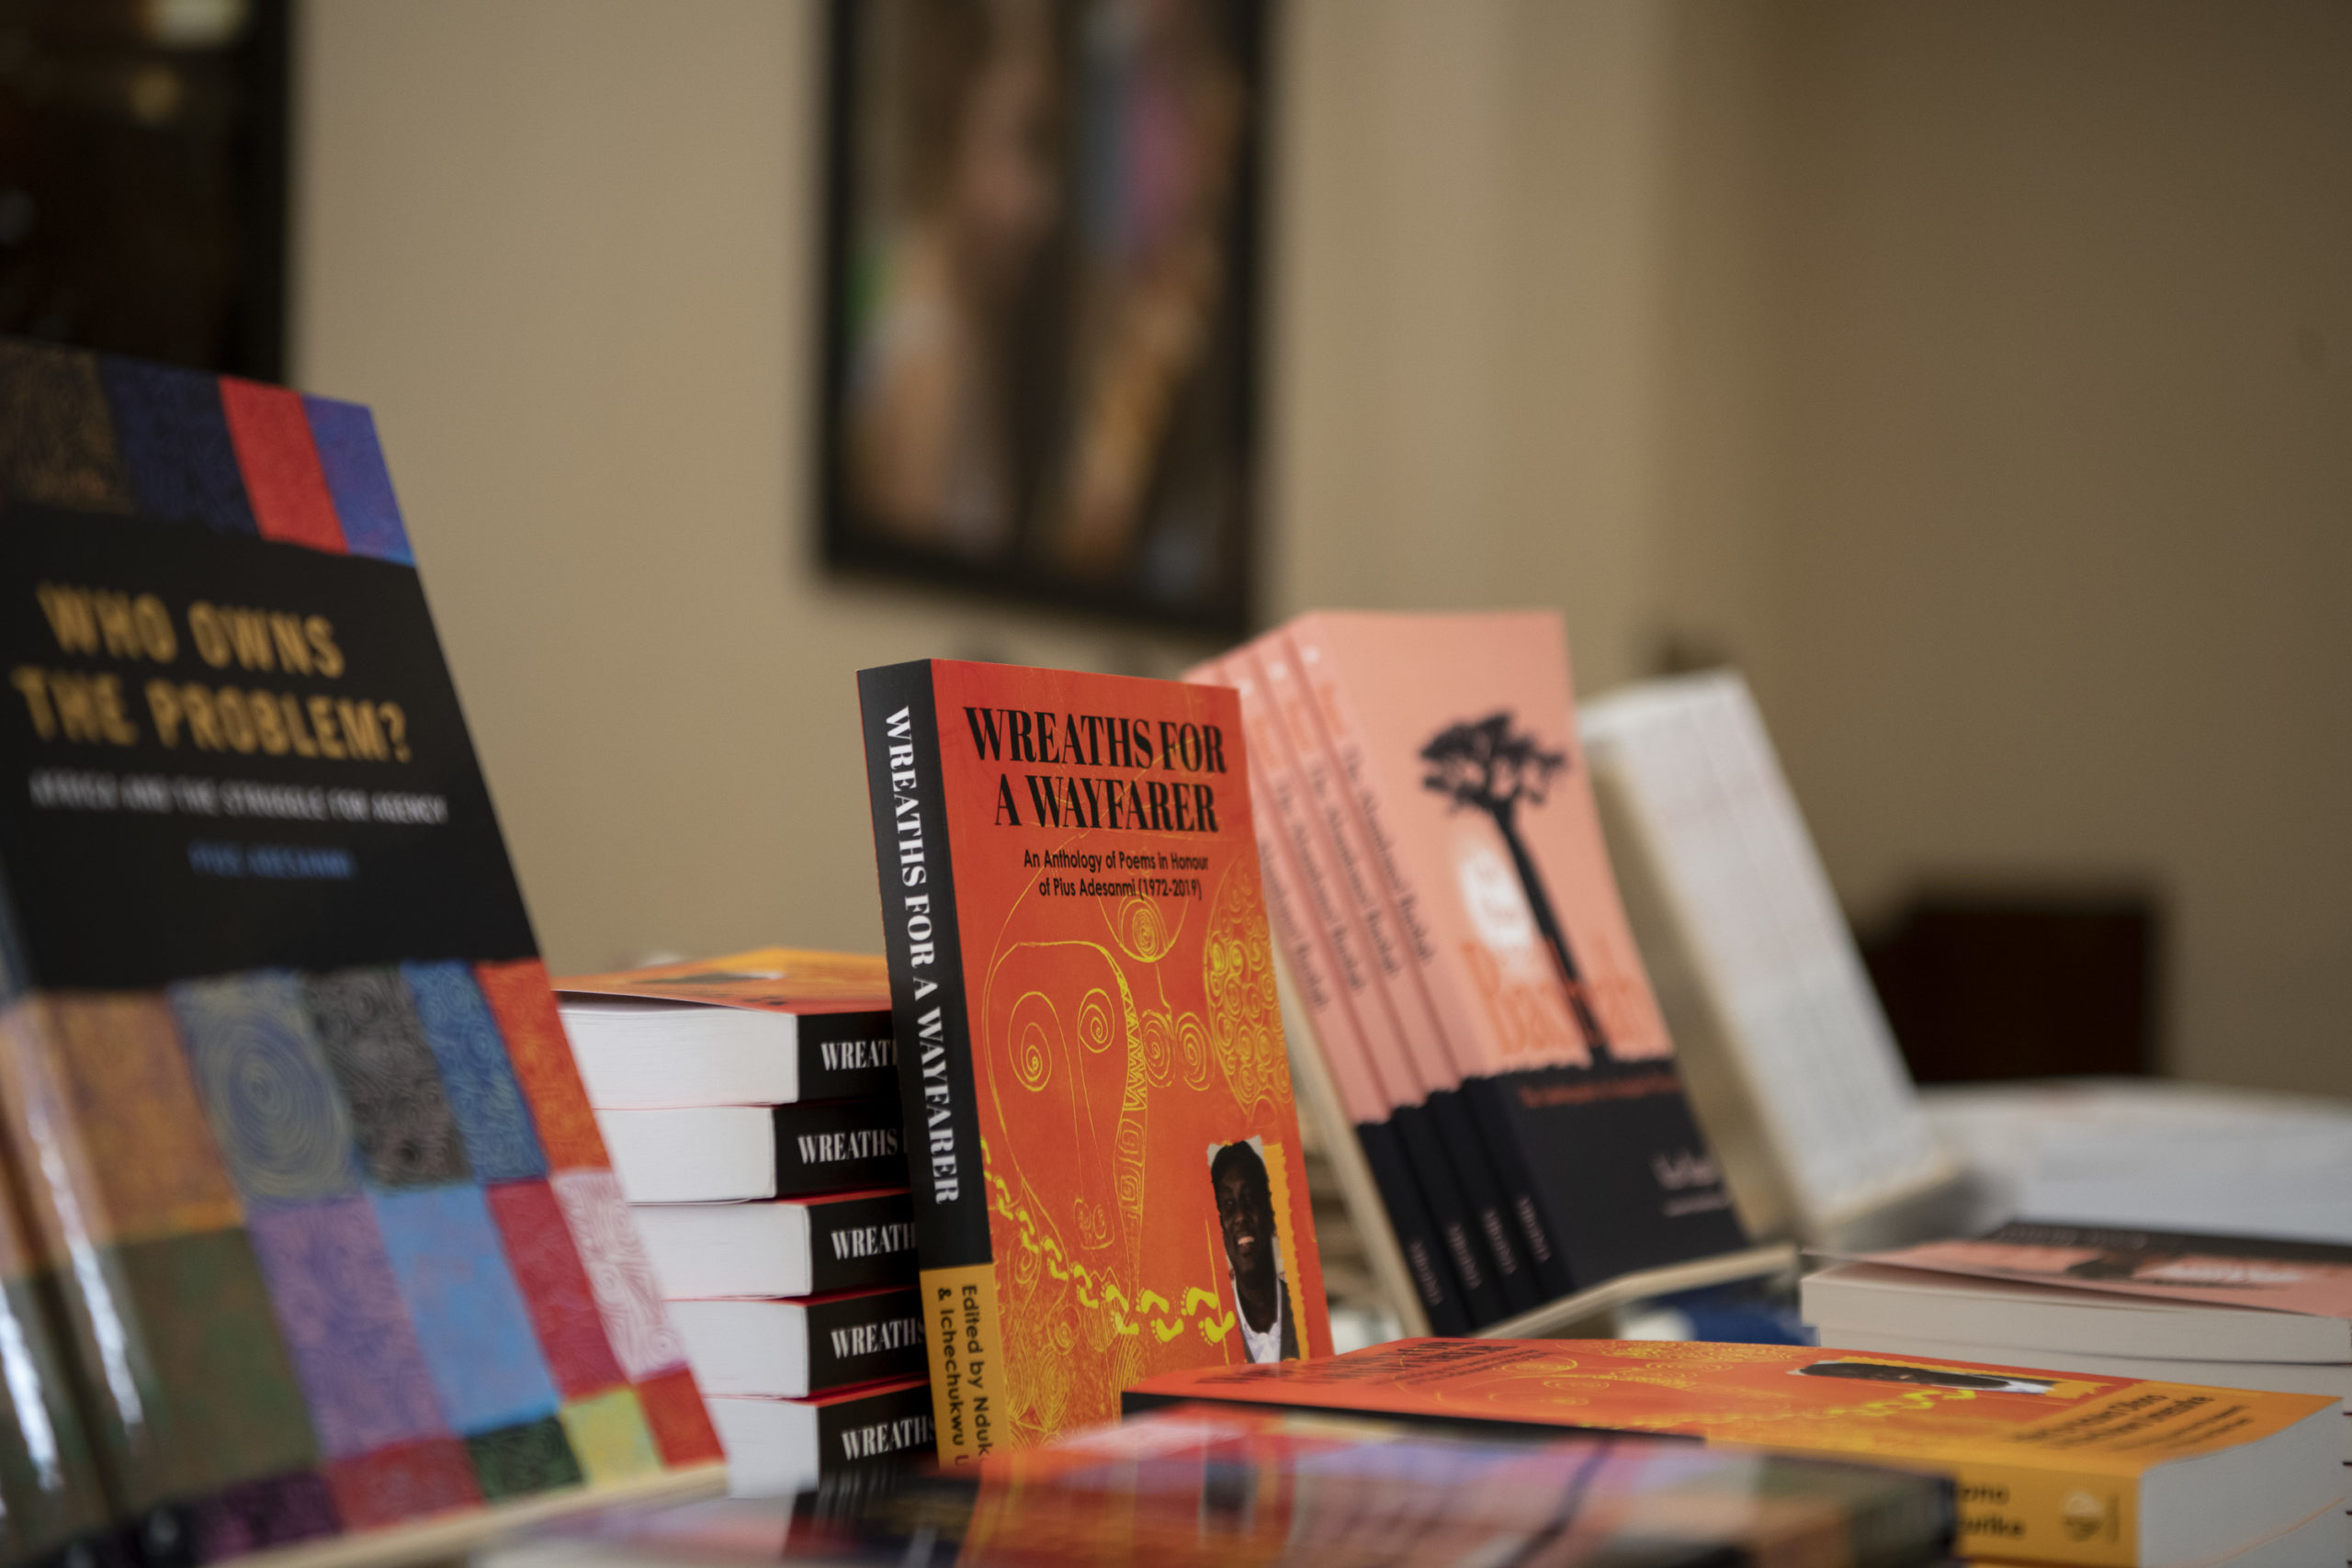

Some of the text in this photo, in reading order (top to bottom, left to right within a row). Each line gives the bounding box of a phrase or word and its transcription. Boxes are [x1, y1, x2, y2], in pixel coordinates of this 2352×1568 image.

[35, 581, 345, 680] WHO OWNS
[10, 663, 413, 764] THE PROBLEM?
[963, 706, 1227, 774] WREATHS FOR
[994, 773, 1220, 833] A WAYFARER
[1023, 849, 1209, 874] An Anthology of Poems in Honour
[1038, 877, 1203, 901] of Pius Adesanmi (1972-2019)
[886, 705, 959, 1205] WREATHS FOR A WAYFARER
[797, 1128, 899, 1166] WREATHS
[830, 1222, 917, 1261] WREATH
[937, 1288, 952, 1302] &
[961, 1284, 994, 1460] Edited by Nduk
